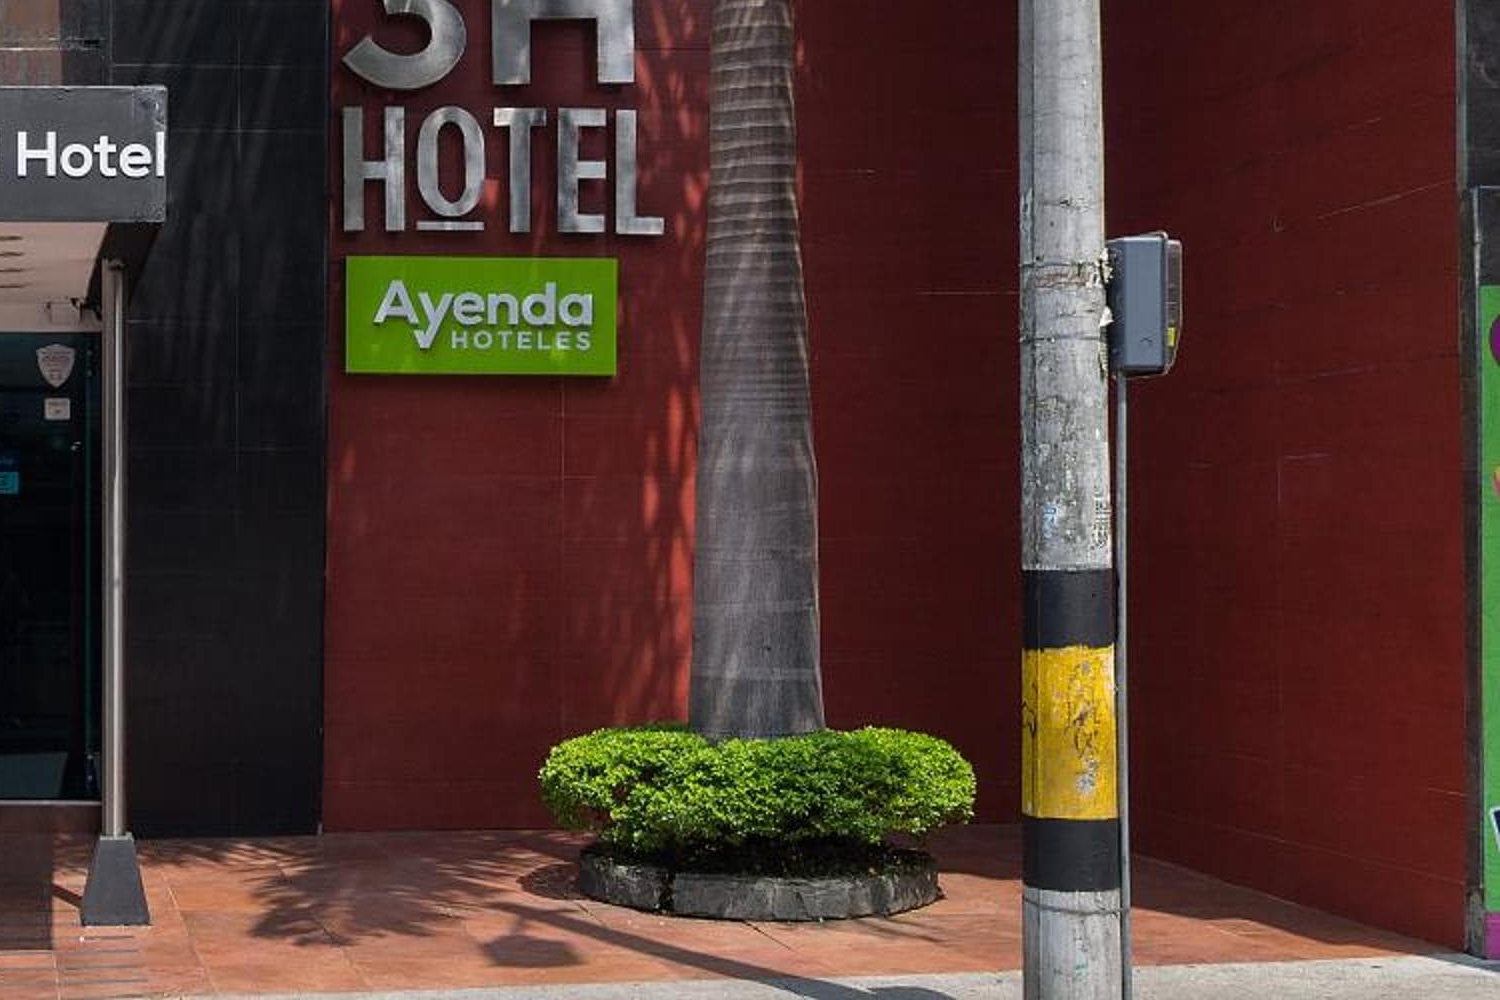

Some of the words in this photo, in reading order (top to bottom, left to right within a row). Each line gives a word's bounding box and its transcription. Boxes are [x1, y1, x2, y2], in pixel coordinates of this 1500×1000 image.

[17, 131, 165, 178] Hotel
[343, 106, 665, 235] HOTEL
[373, 280, 593, 349] Ayenda
[451, 331, 592, 351] HOTELES
